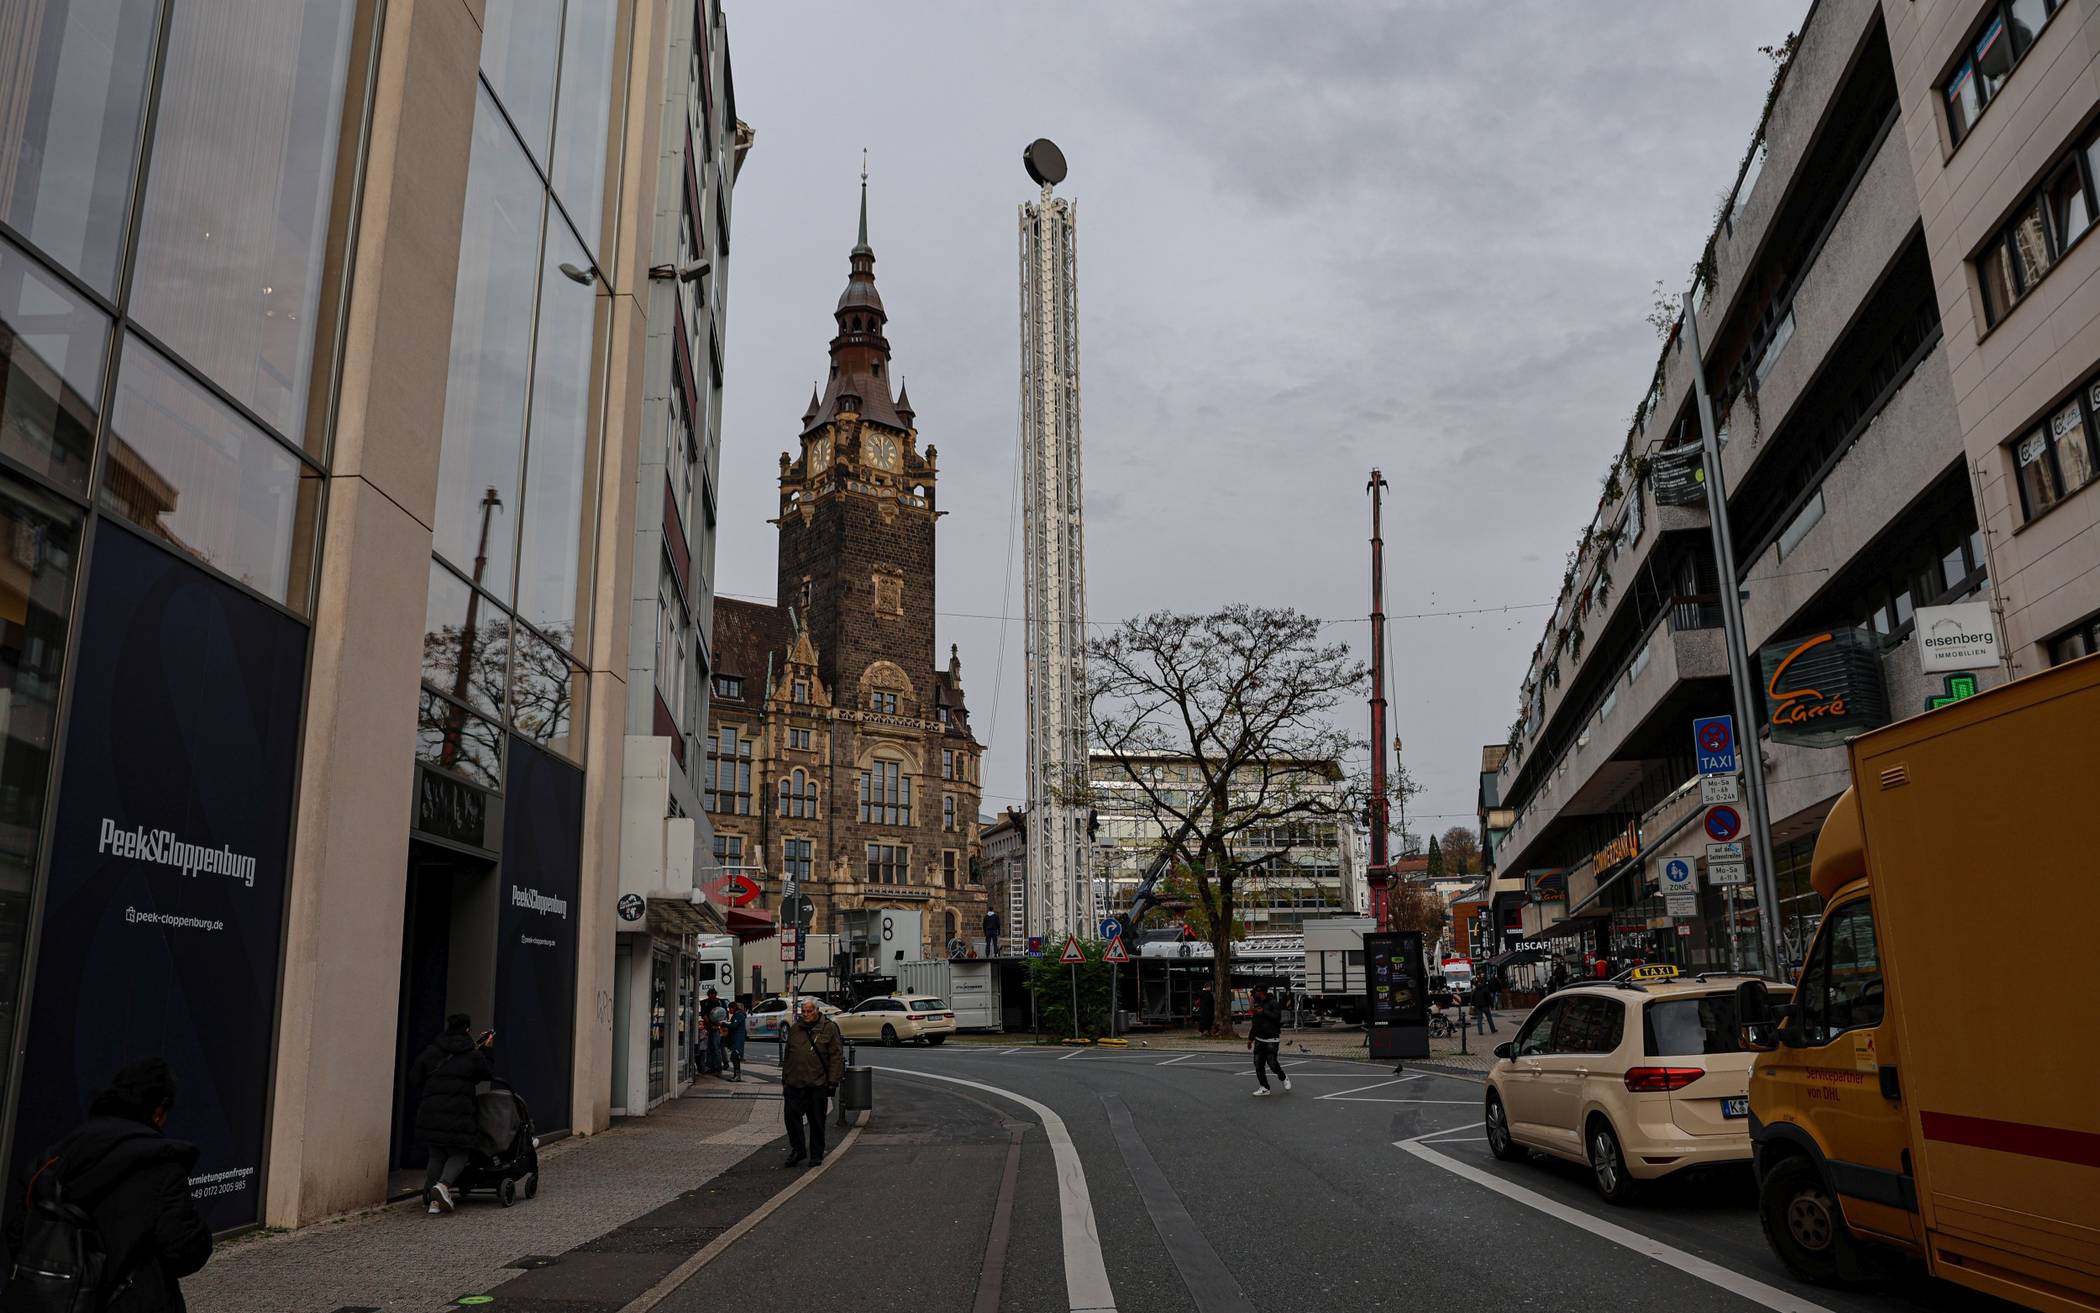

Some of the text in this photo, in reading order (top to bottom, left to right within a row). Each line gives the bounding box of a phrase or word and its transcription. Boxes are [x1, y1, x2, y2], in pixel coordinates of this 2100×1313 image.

[1925, 632, 1993, 647] eisenberg
[1935, 649, 1986, 659] IMMOBILIEN
[1771, 694, 1848, 726] Carré
[1700, 755, 1732, 770] TAXI
[98, 817, 257, 888] Peek&Cloppenburg
[1669, 883, 1688, 891] ZONE
[136, 911, 224, 932] peek-cloppenburg.de
[1643, 967, 1670, 976] TAXI
[1806, 1066, 1865, 1084] Servicepartner
[1807, 1086, 1841, 1102] von DHL
[203, 1185, 218, 1197] 0172
[219, 1182, 234, 1194] 2005
